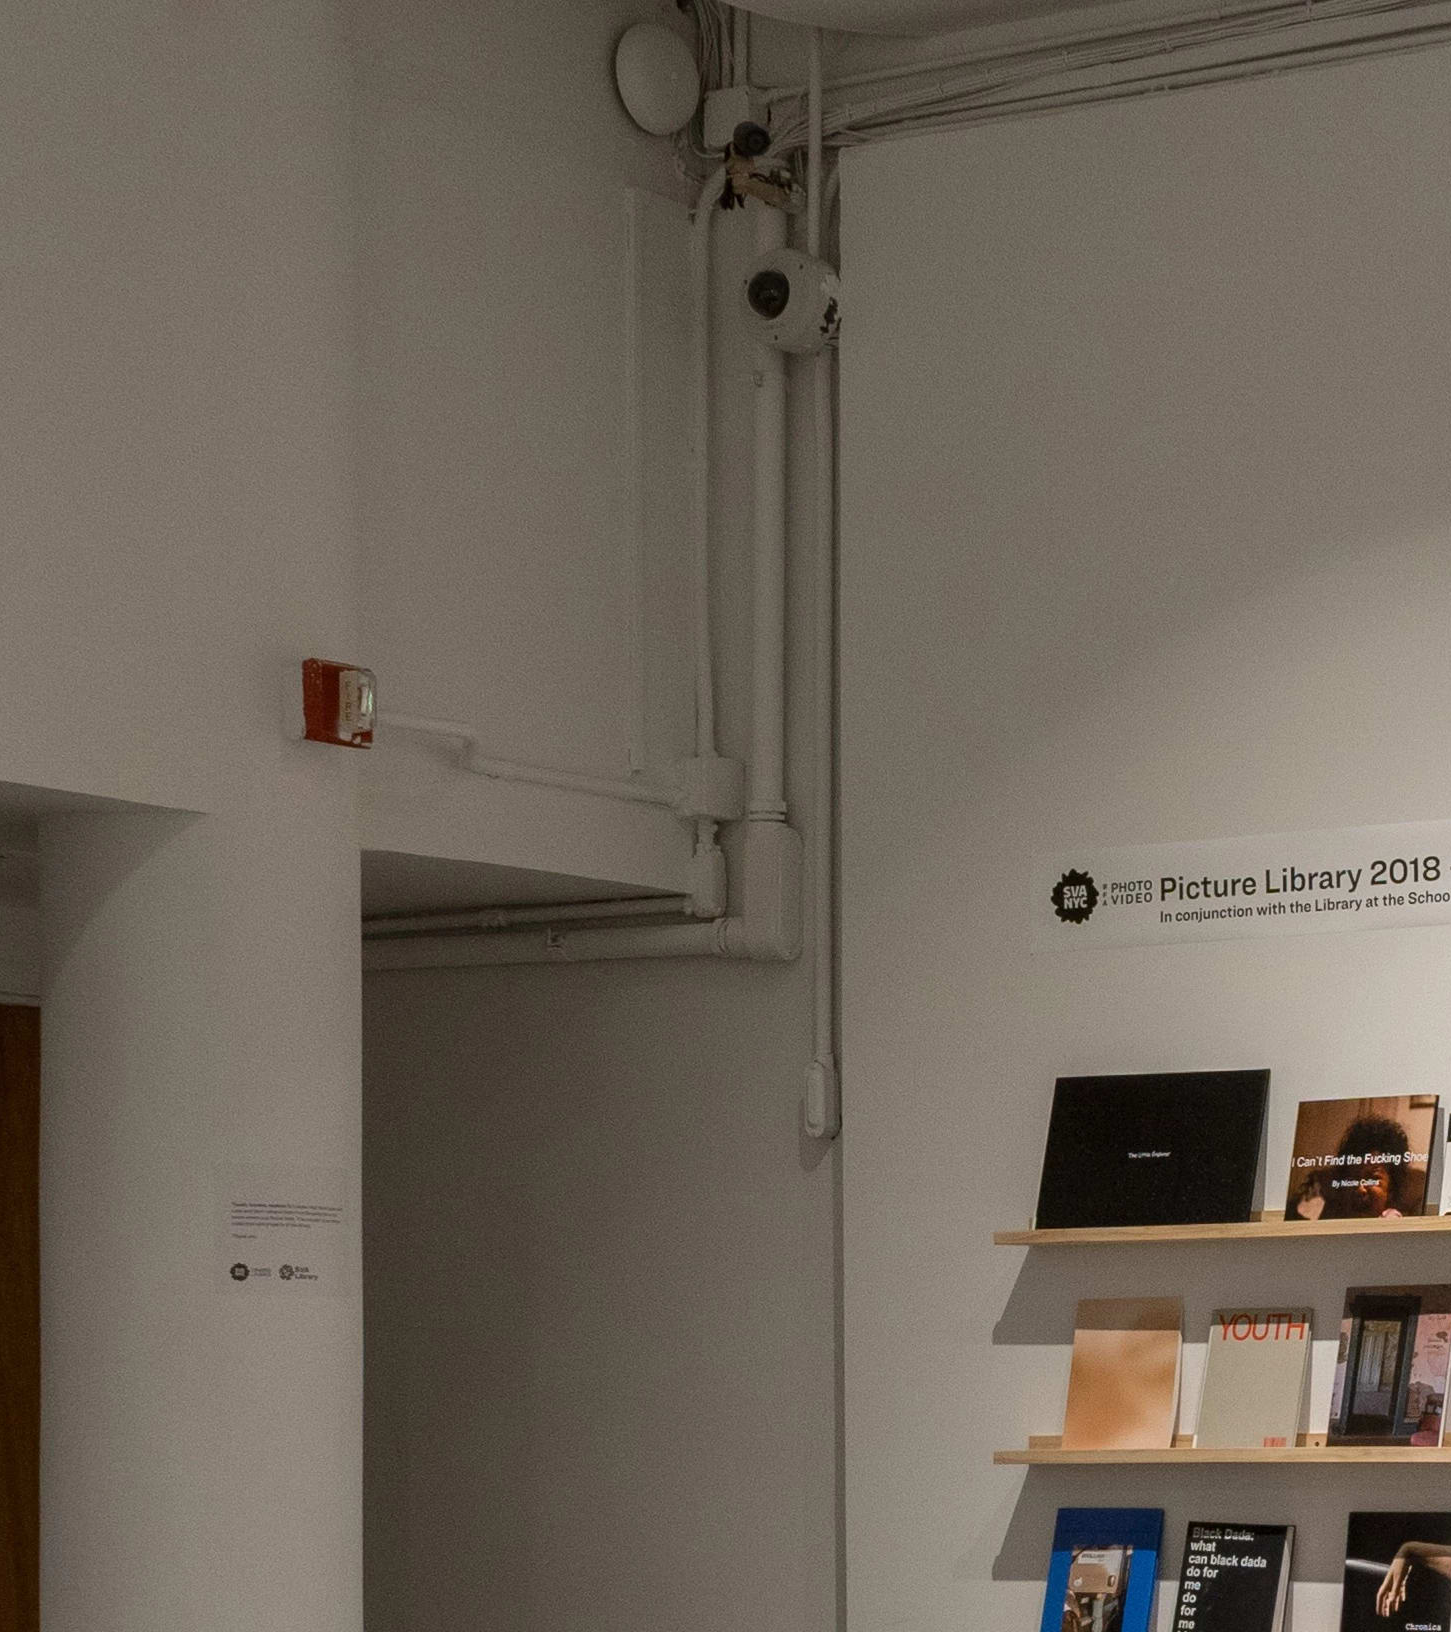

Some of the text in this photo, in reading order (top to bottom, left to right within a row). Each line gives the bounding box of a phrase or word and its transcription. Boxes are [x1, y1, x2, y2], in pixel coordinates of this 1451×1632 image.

[1160, 876, 1257, 901] Picture
[1265, 866, 1362, 893] Library
[1370, 855, 1441, 885] 2018
[1063, 885, 1087, 898] SVA
[1111, 880, 1153, 893] PHOTO
[1063, 897, 1088, 909] NYC
[1112, 892, 1153, 905] VIDEO
[1160, 911, 1172, 923] In
[1175, 905, 1253, 923] conjunction
[1257, 901, 1287, 916] with
[1290, 900, 1311, 914] the
[1315, 897, 1362, 912] Library
[1365, 896, 1379, 908] at
[1383, 893, 1405, 906] the
[1324, 1154, 1346, 1166] Find
[1347, 1154, 1362, 1165] the
[1364, 1152, 1401, 1166] Fucking
[1219, 1312, 1306, 1341] YOUTH
[1192, 1527, 1222, 1540] Black
[1190, 1540, 1217, 1552] what
[1188, 1554, 1267, 1568] can black dada
[1186, 1566, 1219, 1578] do for
[1184, 1581, 1201, 1590] me
[1182, 1592, 1197, 1603] do
[1180, 1604, 1197, 1616] for
[1178, 1619, 1195, 1629] me
[1405, 1622, 1442, 1632] Chronica
